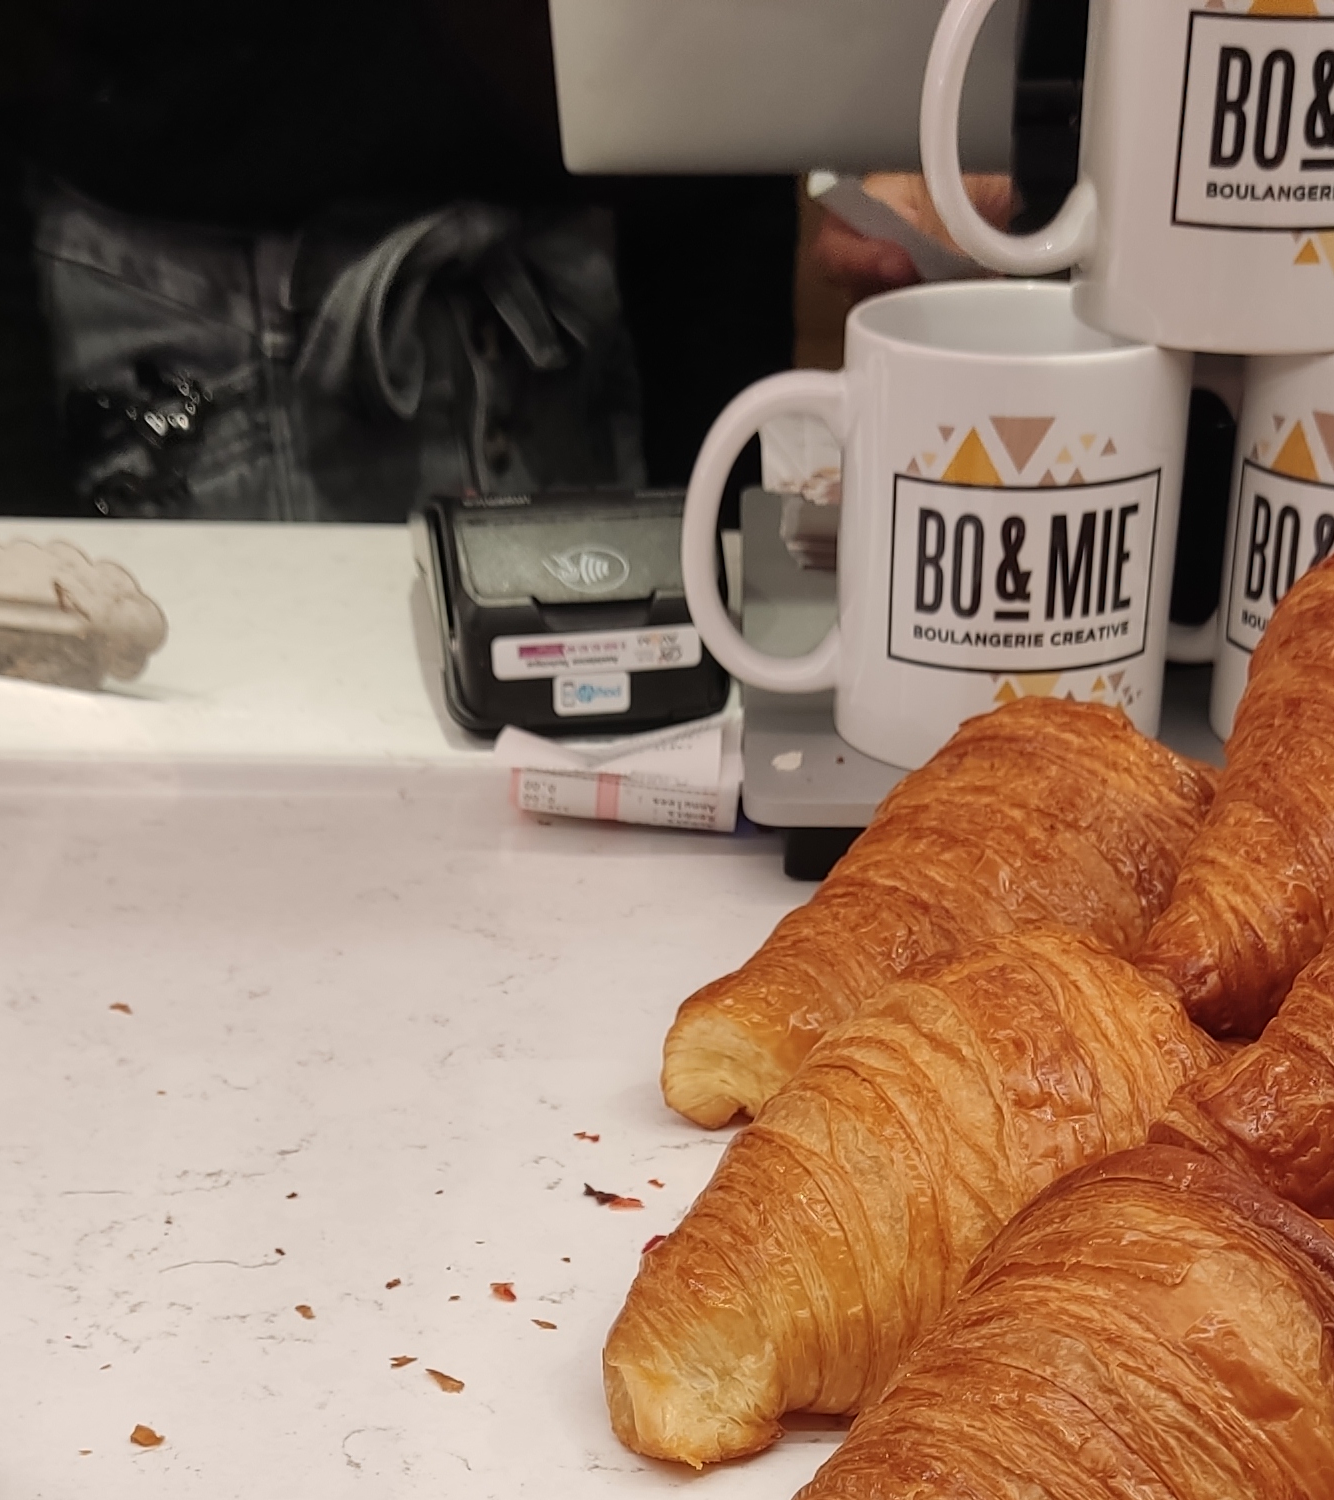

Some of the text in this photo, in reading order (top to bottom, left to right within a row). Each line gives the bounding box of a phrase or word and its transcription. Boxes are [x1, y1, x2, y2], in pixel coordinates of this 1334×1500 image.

[1209, 45, 1296, 172] BO
[915, 506, 985, 619] BO
[1044, 502, 1139, 621] MIE
[913, 620, 1130, 648] BOULANGERIE CREATIVE
